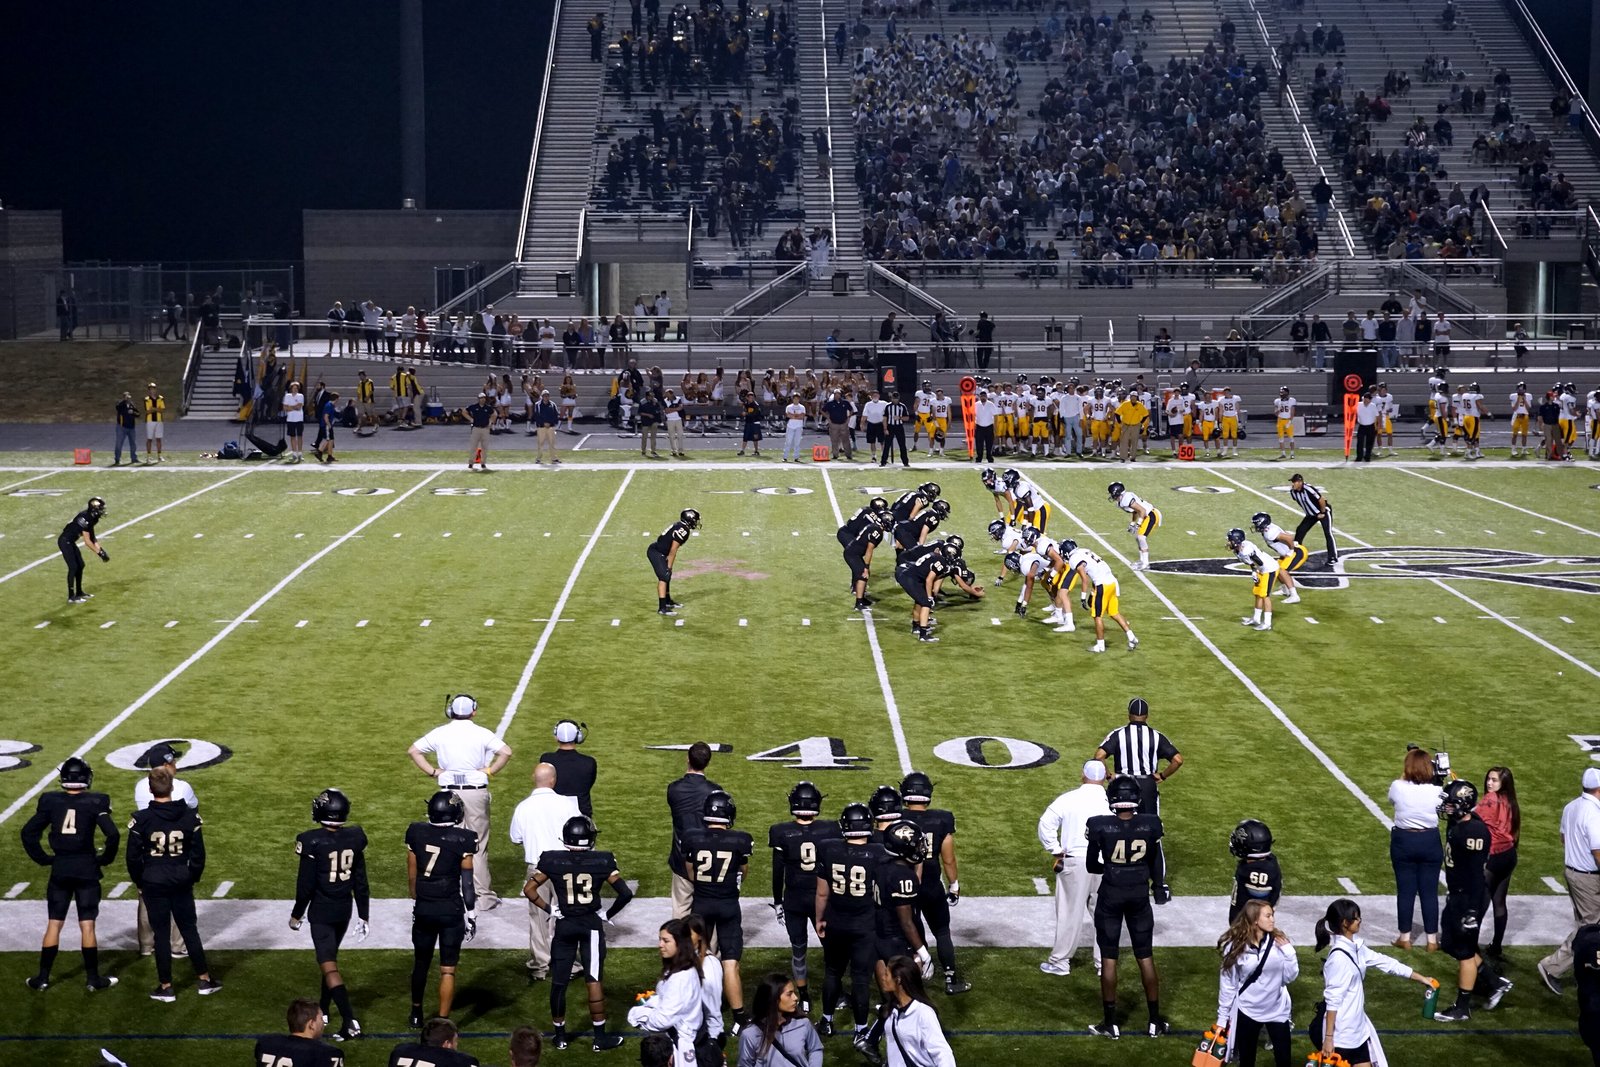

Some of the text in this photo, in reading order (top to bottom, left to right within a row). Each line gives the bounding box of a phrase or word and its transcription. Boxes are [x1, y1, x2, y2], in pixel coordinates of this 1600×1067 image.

[884, 369, 895, 383] 4
[1223, 402, 1235, 412] 62
[1180, 446, 1193, 457] 50
[61, 808, 77, 835] 4
[150, 830, 184, 857] 36
[800, 841, 817, 871] 9
[1110, 839, 1147, 864] 42
[1466, 838, 1484, 851] 90
[328, 848, 355, 883] 19
[423, 844, 441, 877] 7
[696, 849, 733, 883] 27
[562, 873, 594, 905] 13
[831, 863, 867, 897] 58
[899, 879, 914, 893] 10
[1249, 871, 1269, 886] 60
